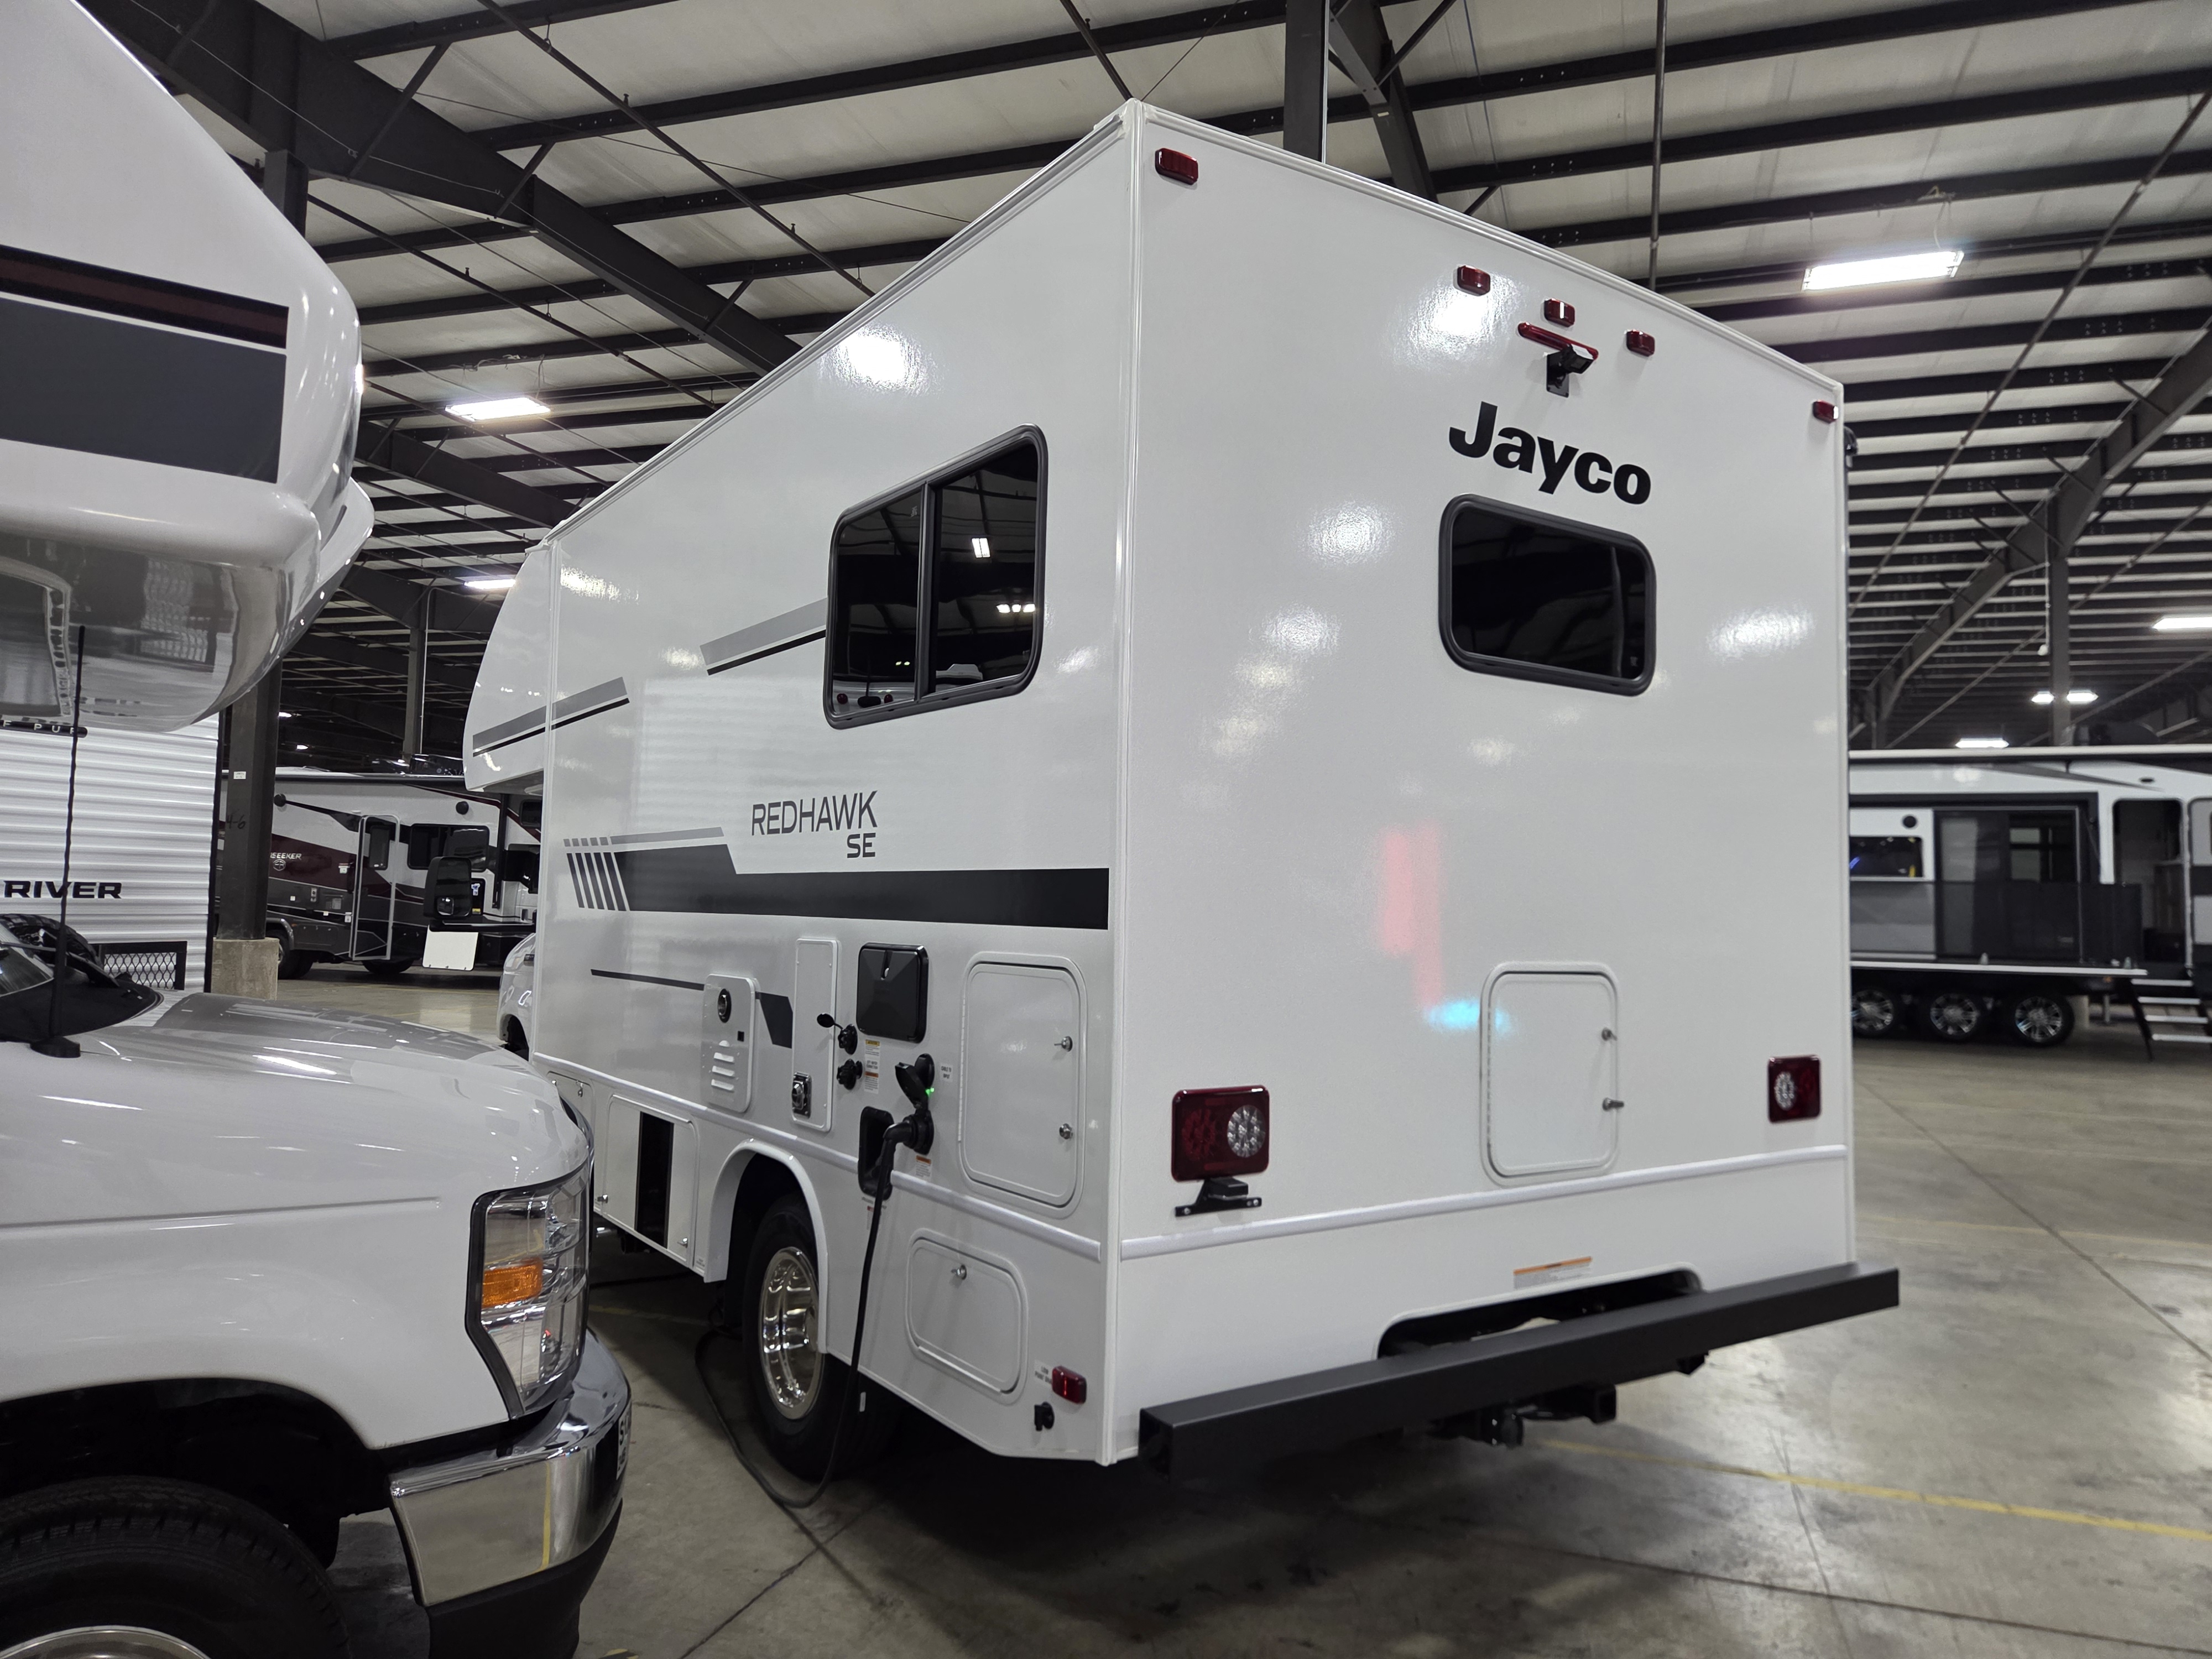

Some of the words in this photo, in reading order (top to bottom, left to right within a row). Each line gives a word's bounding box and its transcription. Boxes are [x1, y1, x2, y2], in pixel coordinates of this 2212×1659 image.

[1449, 401, 1651, 505] Jayco
[752, 790, 878, 836] REDHAWK
[270, 852, 302, 860] SEEKER
[847, 832, 877, 858] SE
[3, 880, 122, 899] RIVER
